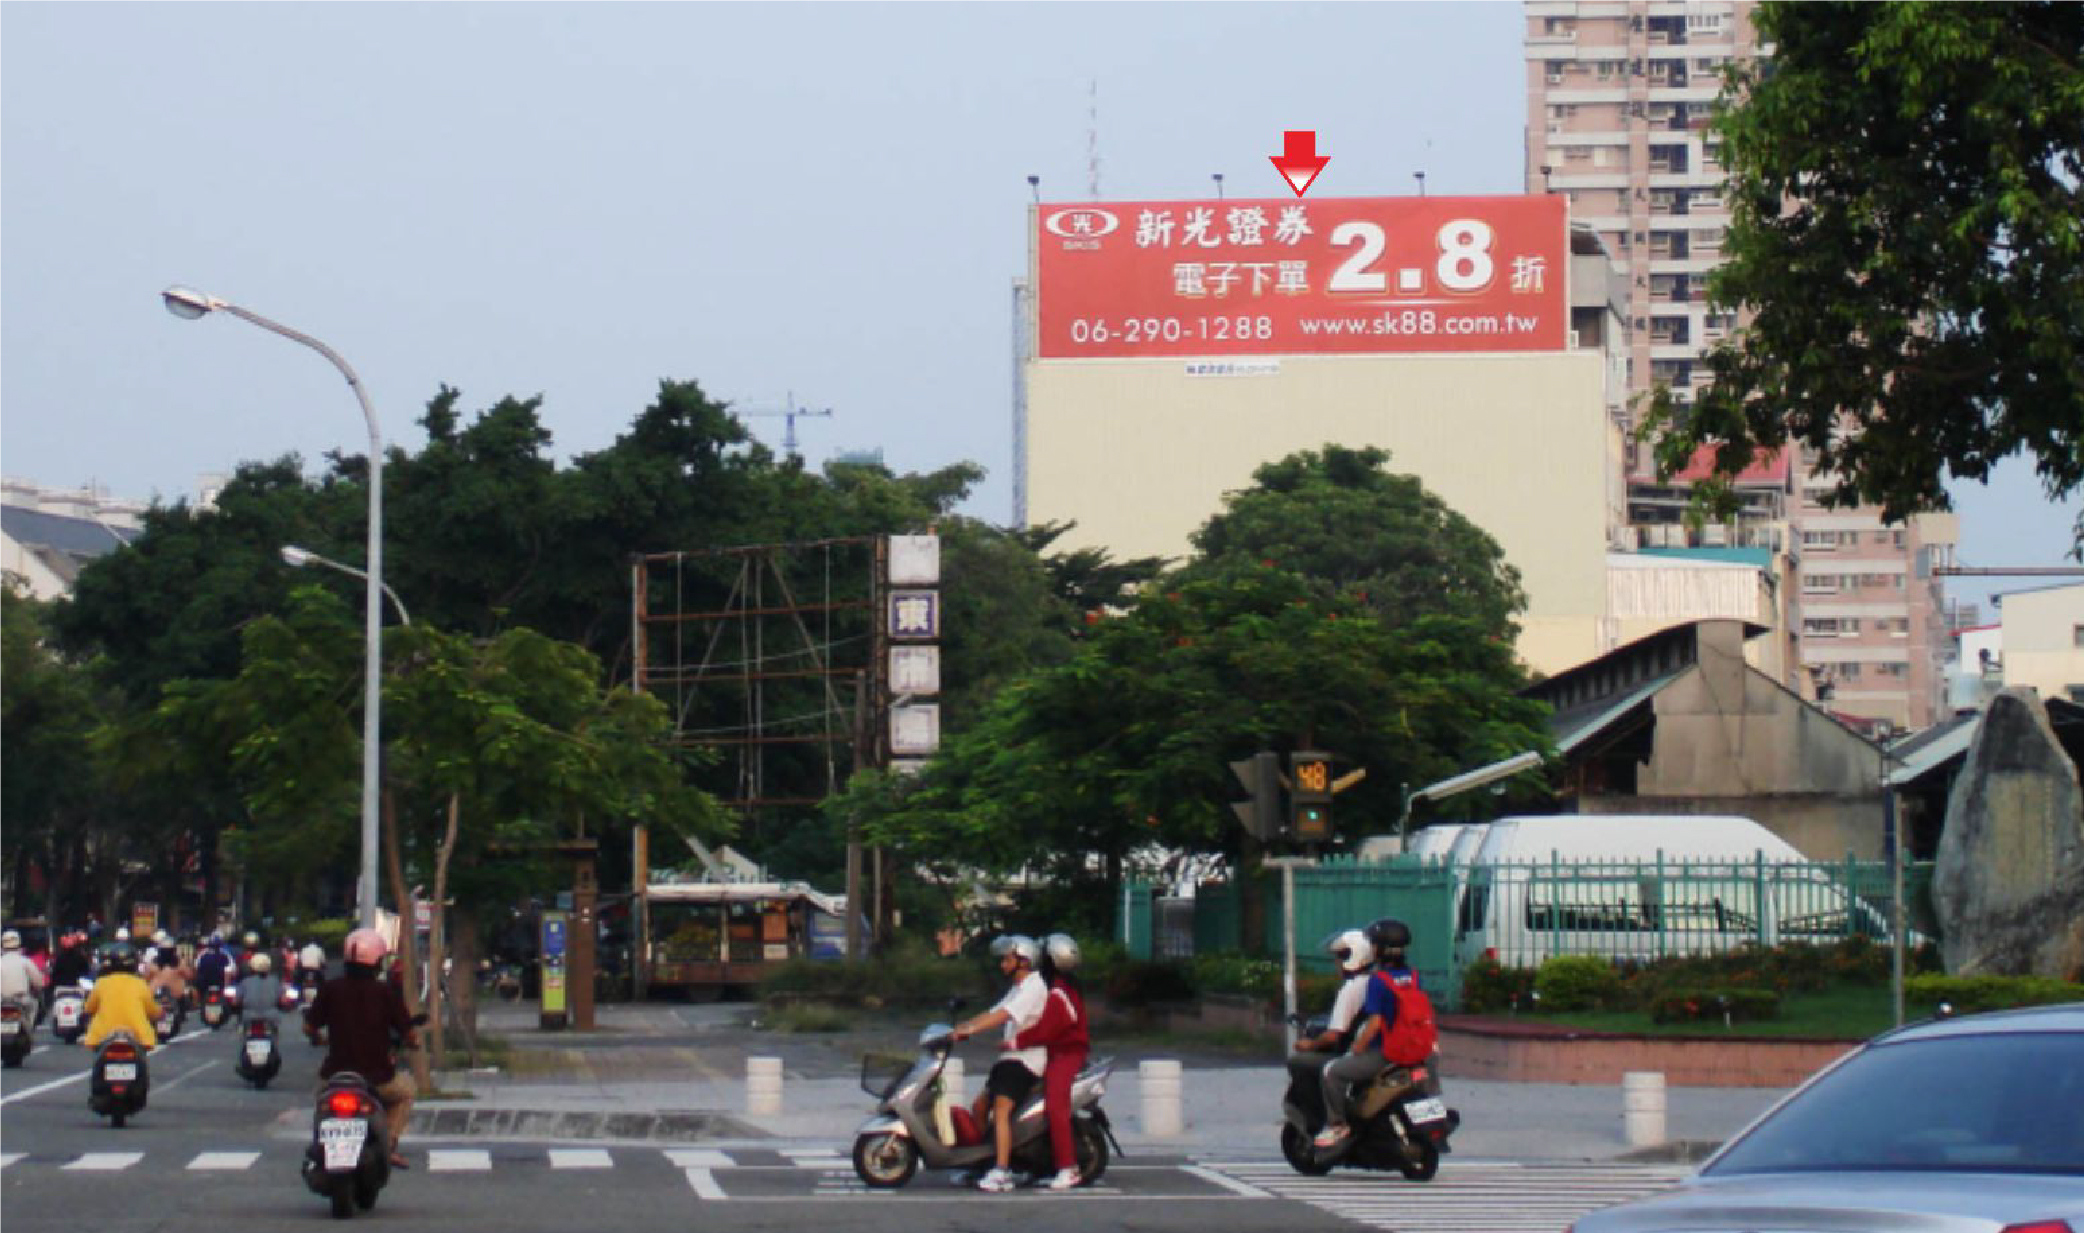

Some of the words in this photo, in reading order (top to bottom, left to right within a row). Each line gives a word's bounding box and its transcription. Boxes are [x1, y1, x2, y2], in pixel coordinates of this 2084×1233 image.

[1135, 205, 1314, 248] 新光證券
[1173, 259, 1311, 297] 電子下單
[1328, 219, 1496, 295] 2.8
[1510, 255, 1547, 294] 折
[1070, 314, 1273, 344] 06-290-1288
[1300, 310, 1539, 336] www.sk88.com.tw
[1296, 760, 1327, 791] 48
